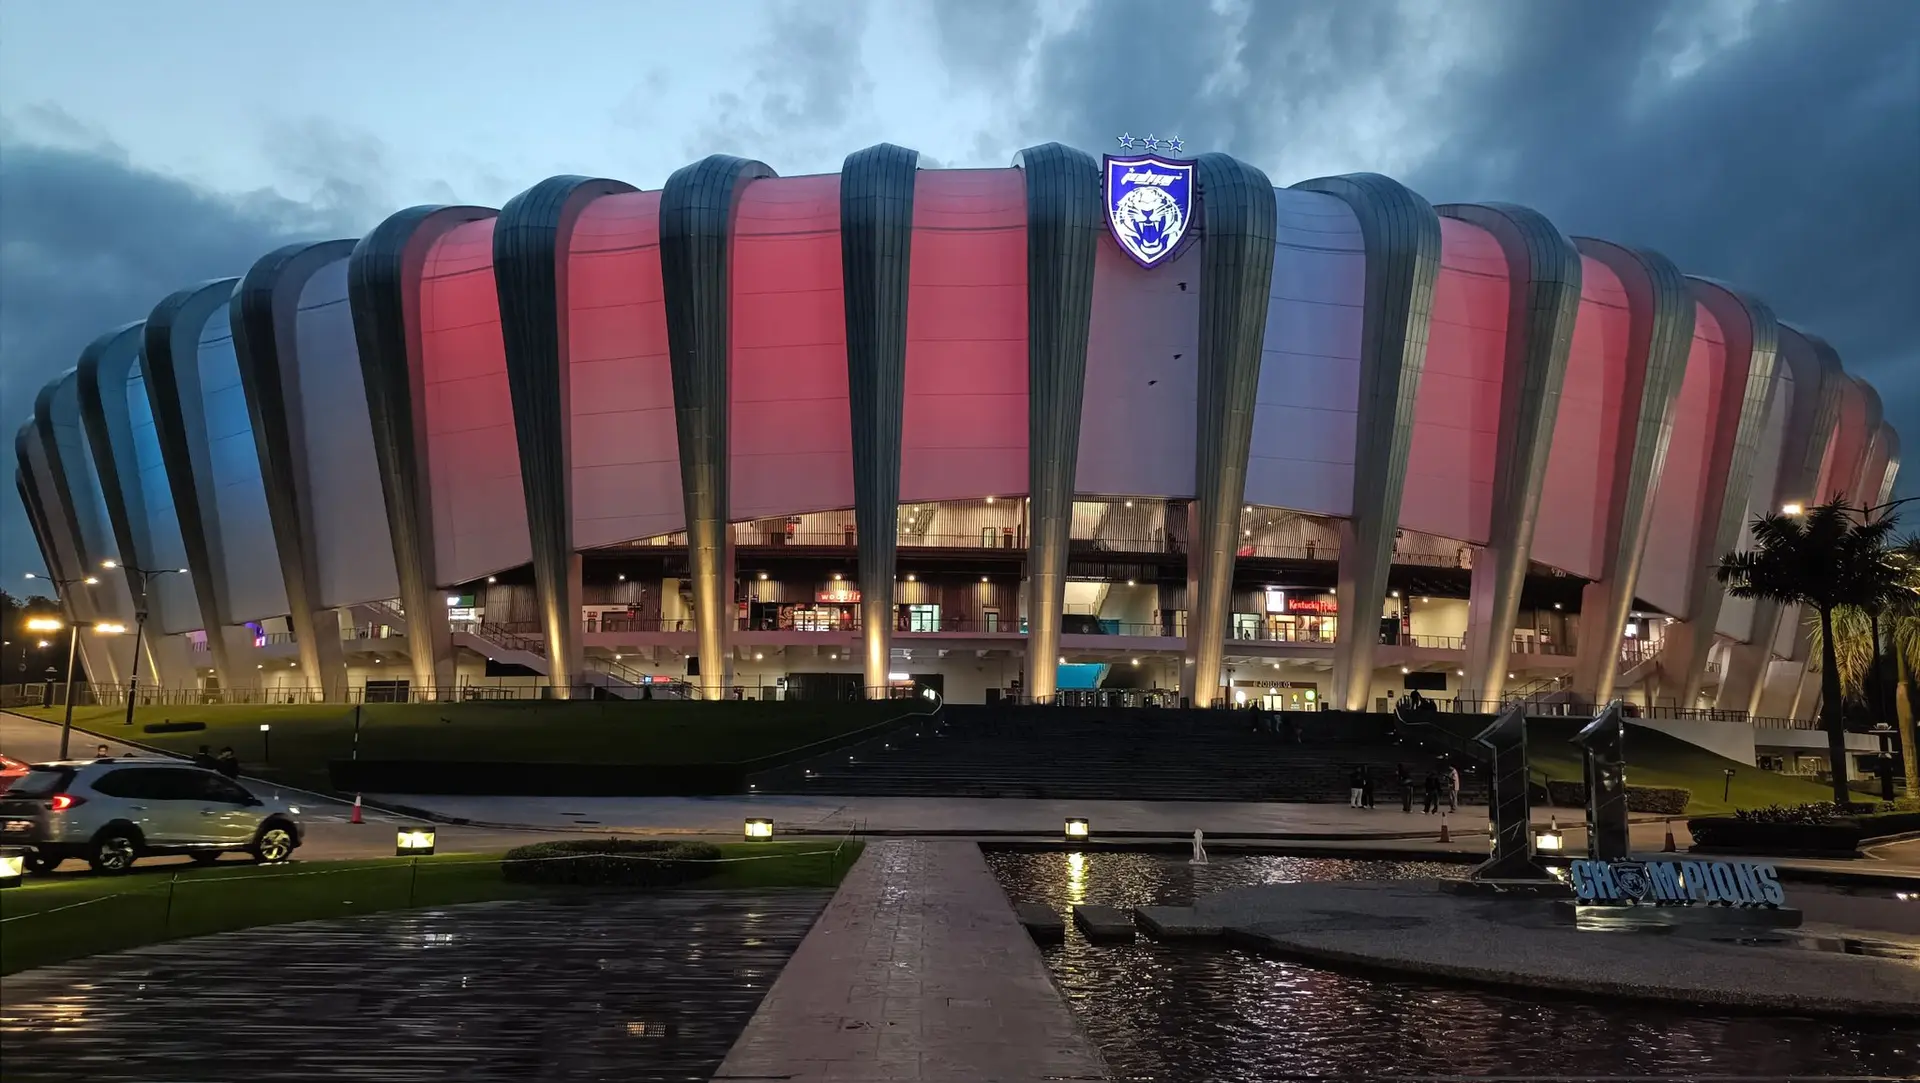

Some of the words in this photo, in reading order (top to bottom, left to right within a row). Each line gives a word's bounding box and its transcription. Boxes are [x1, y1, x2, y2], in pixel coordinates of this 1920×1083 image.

[1289, 600, 1319, 612] Kentucky
[1320, 601, 1337, 611] Fried
[1571, 860, 1786, 907] CHMPIONS
